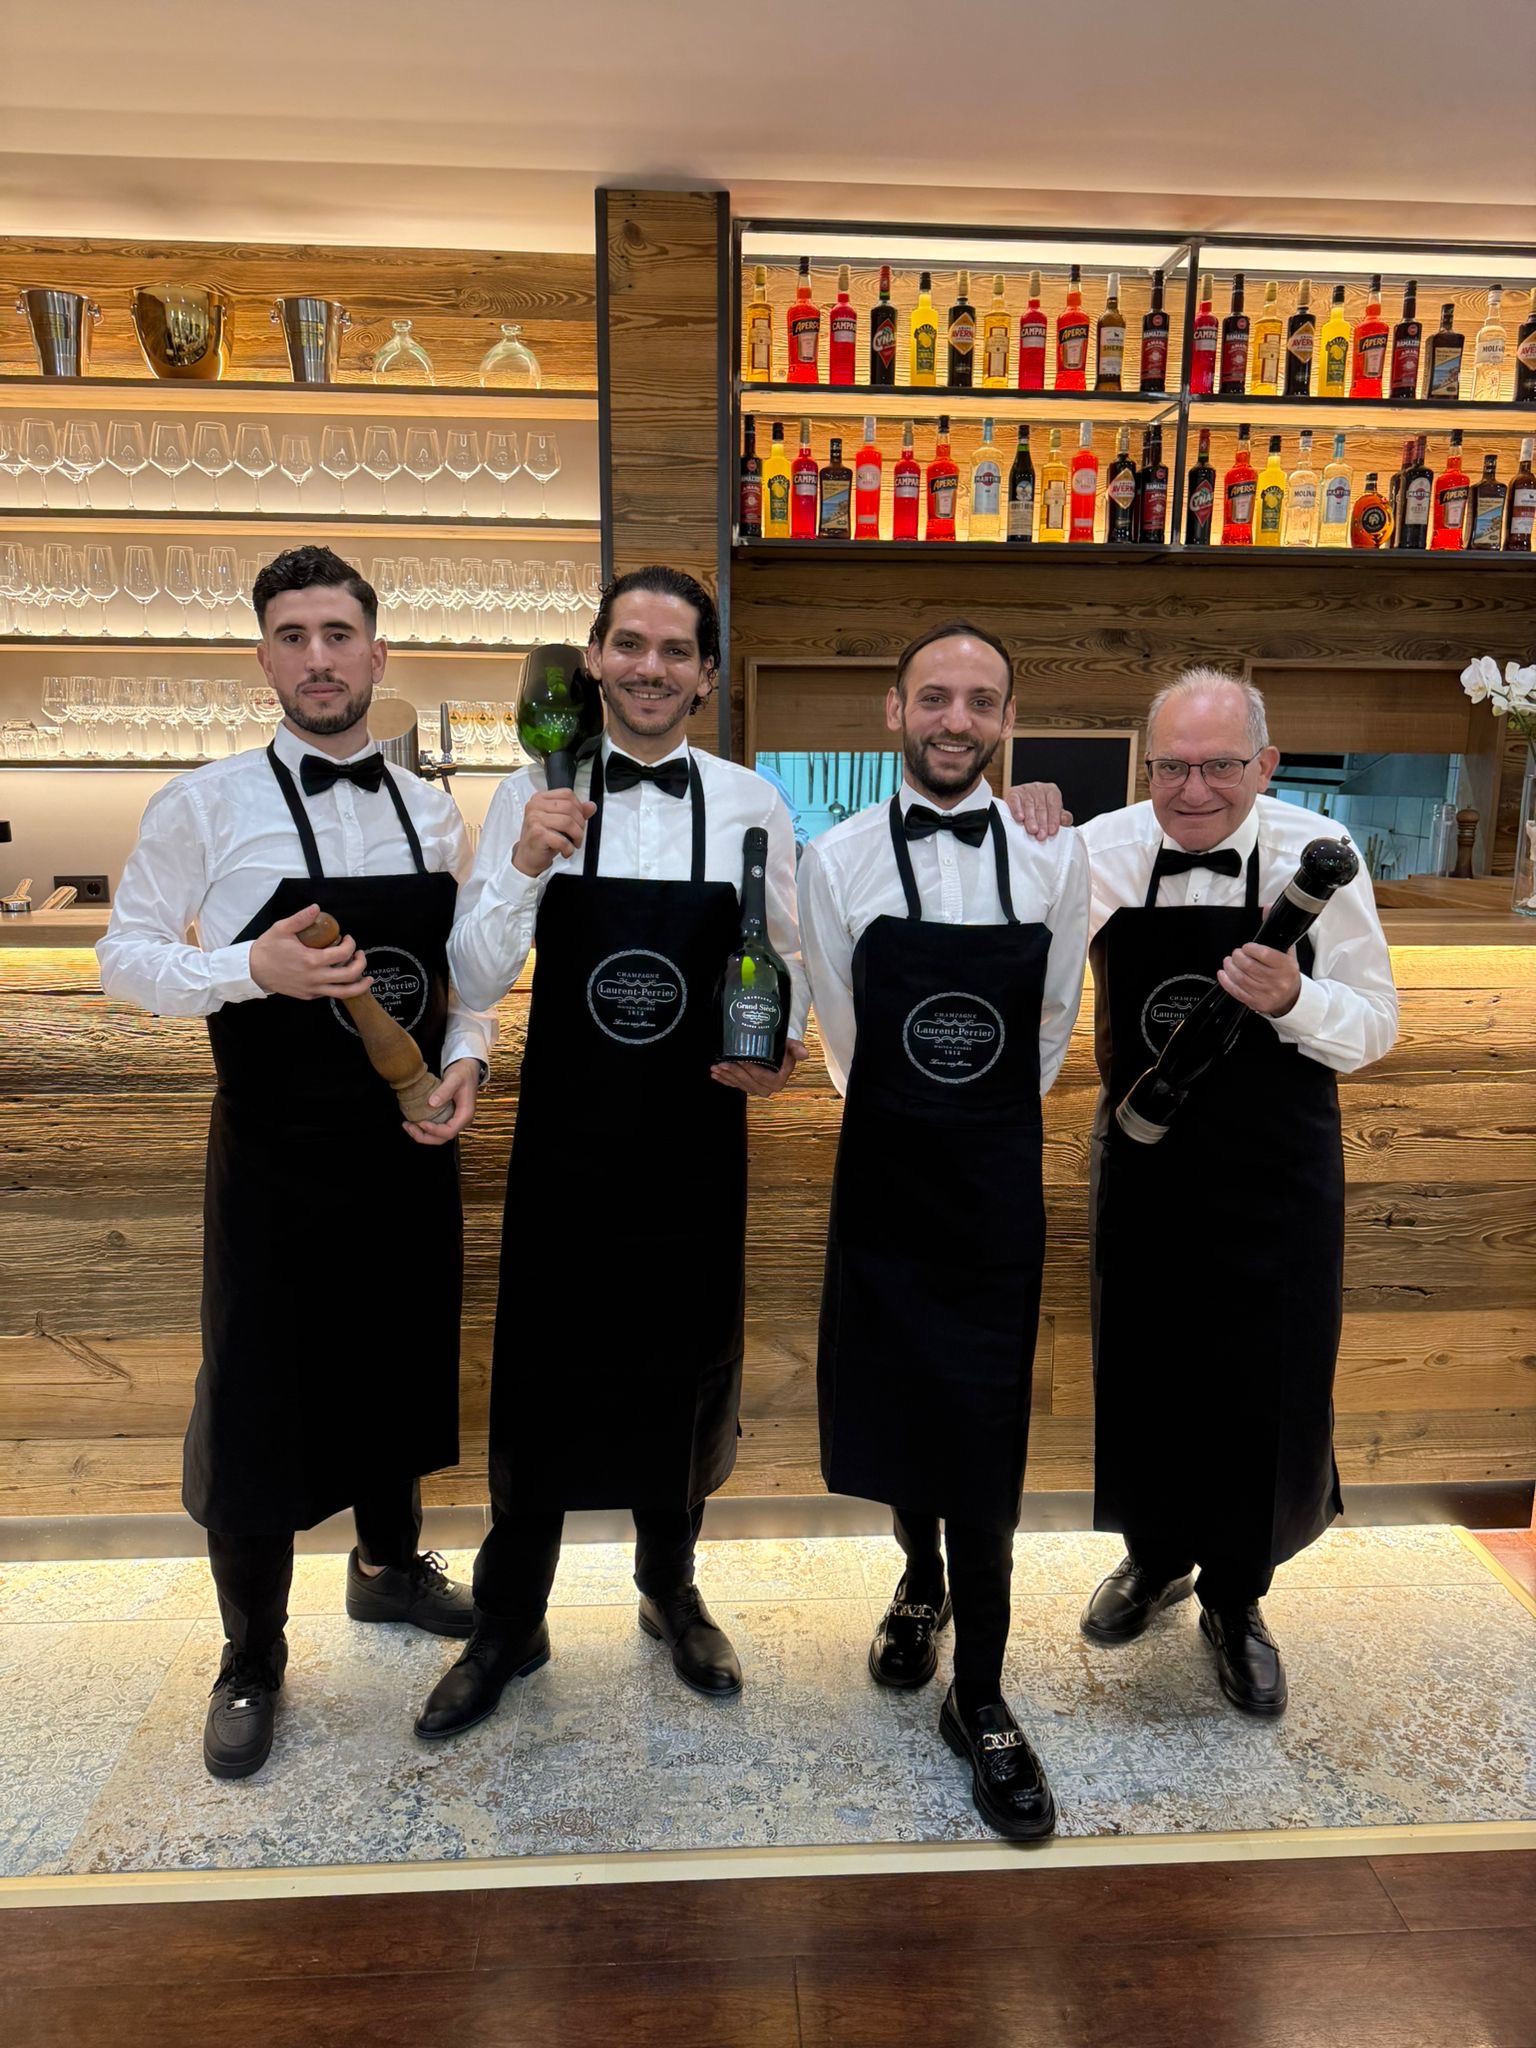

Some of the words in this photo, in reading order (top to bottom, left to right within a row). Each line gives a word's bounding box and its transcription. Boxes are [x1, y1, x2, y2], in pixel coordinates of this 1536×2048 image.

[616, 971, 660, 979] CHAMPAGNE
[371, 980, 417, 993] nt-Perrier
[600, 984, 675, 997] Laurent-Perrier
[916, 1024, 993, 1037] Laurent-Perrier
